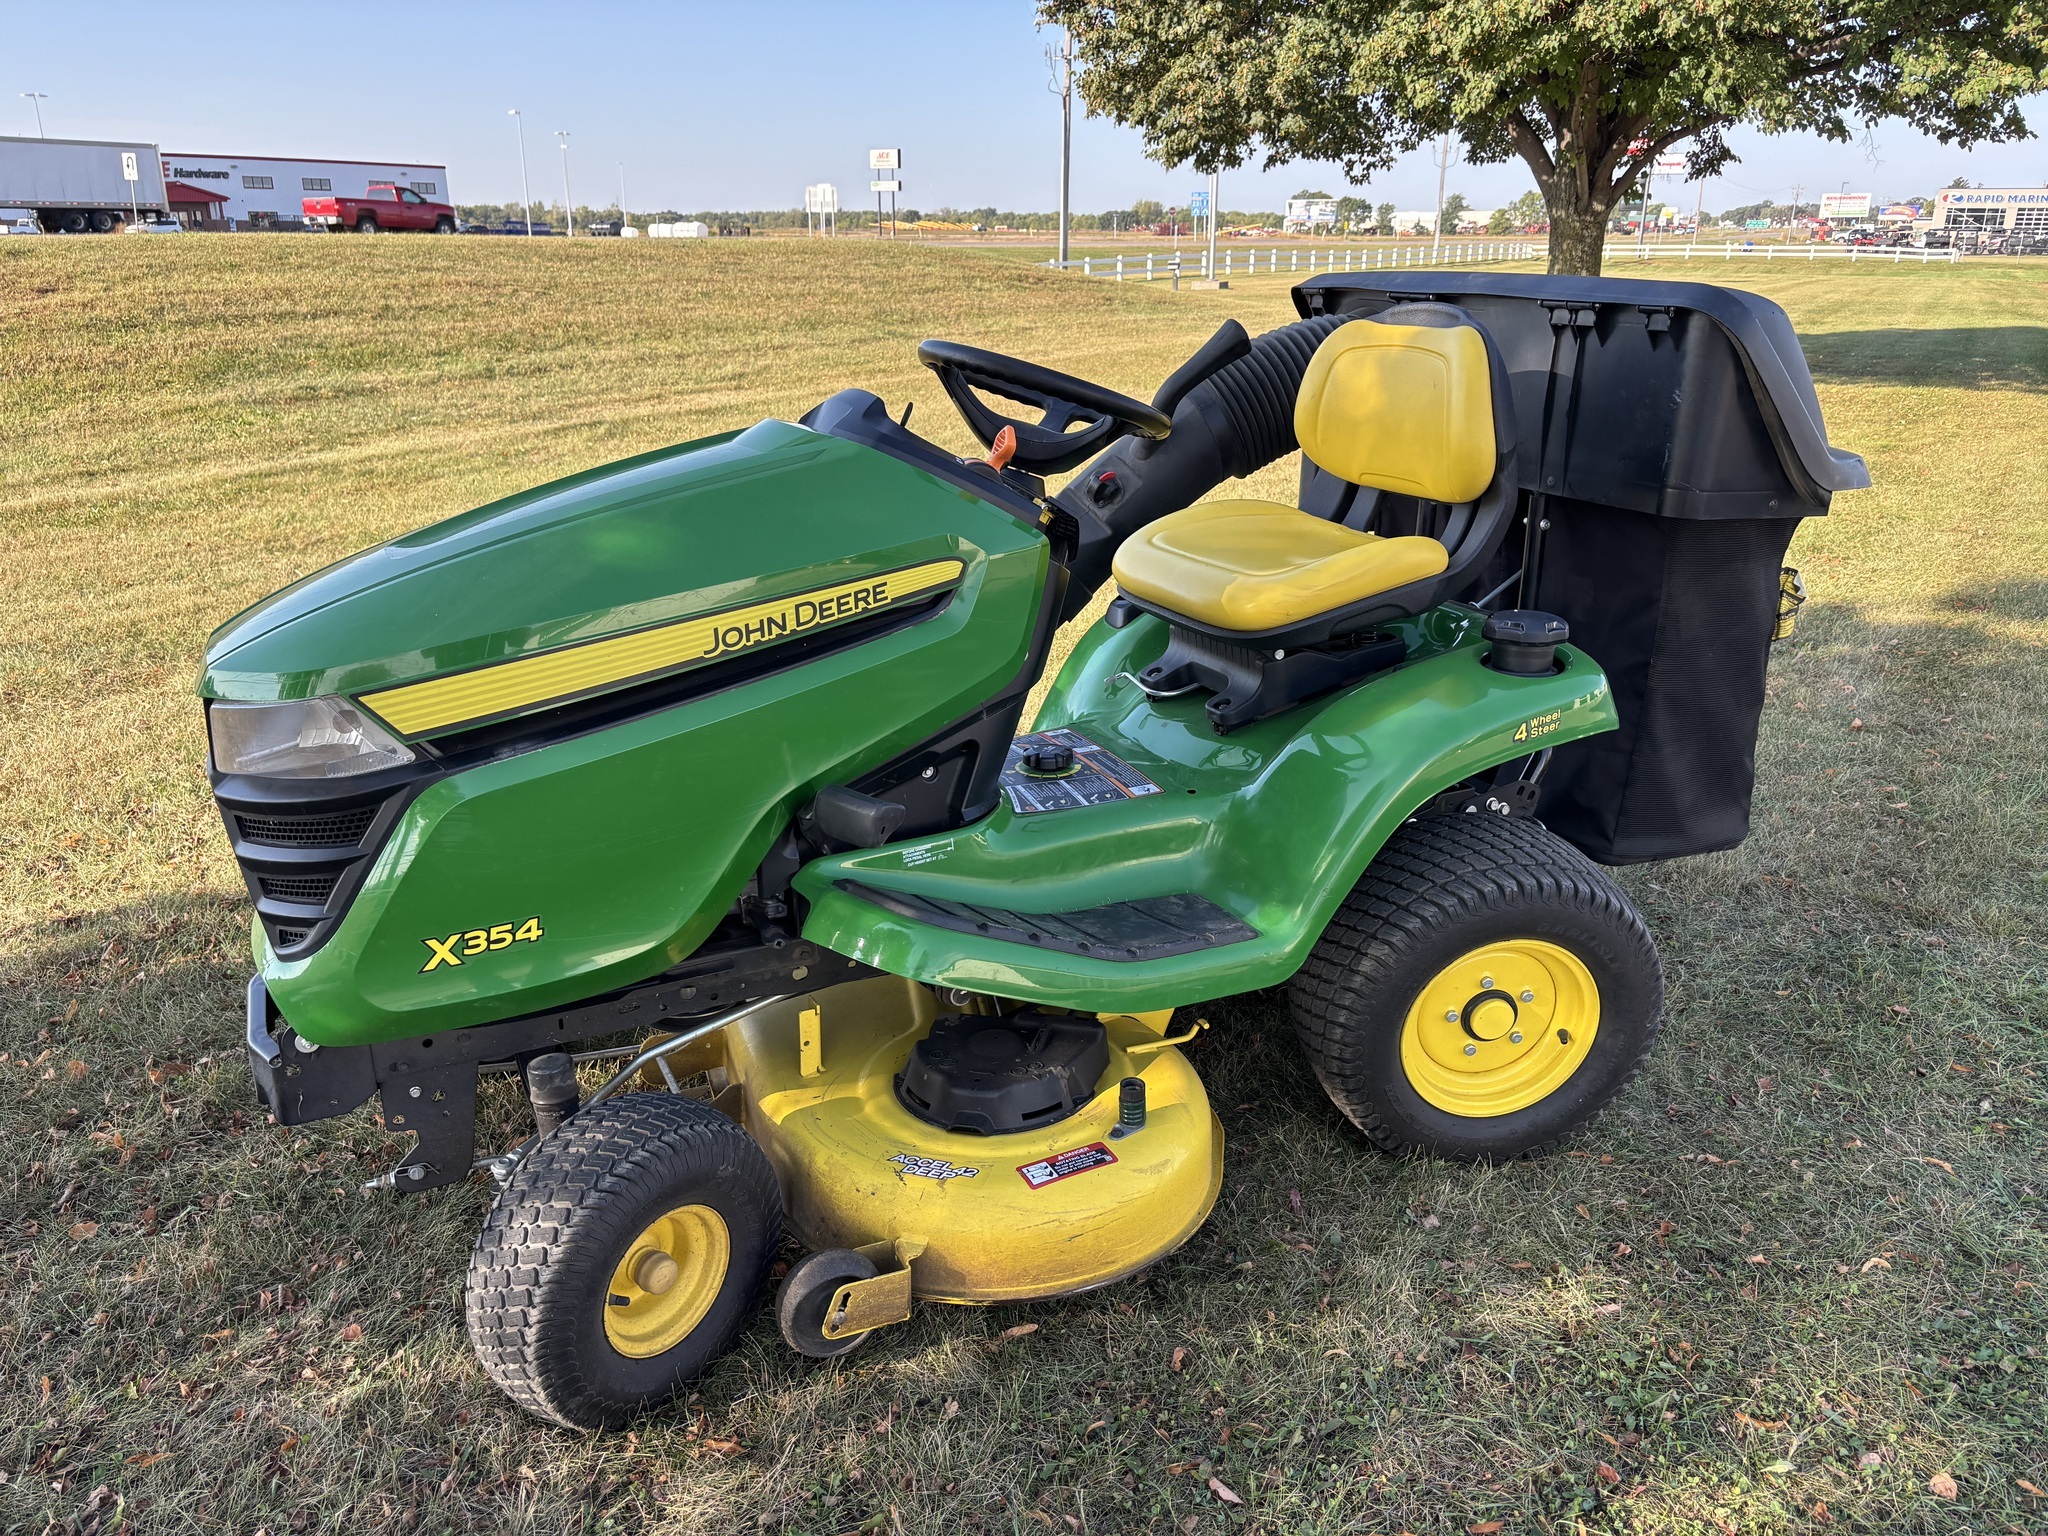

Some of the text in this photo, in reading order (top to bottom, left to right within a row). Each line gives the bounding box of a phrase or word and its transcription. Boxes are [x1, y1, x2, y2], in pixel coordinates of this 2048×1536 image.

[173, 167, 229, 179] Hardware
[1966, 194, 2004, 203] RAPID
[703, 581, 889, 656] JOHN DEERE
[1530, 709, 1561, 728] Wheel
[1513, 722, 1528, 743] 4
[1530, 720, 1561, 739] Steer
[417, 915, 545, 974] X354
[1063, 1147, 1090, 1158] DANGER
[888, 1153, 952, 1171] ACCEL
[901, 1164, 980, 1180] DEEP 42
